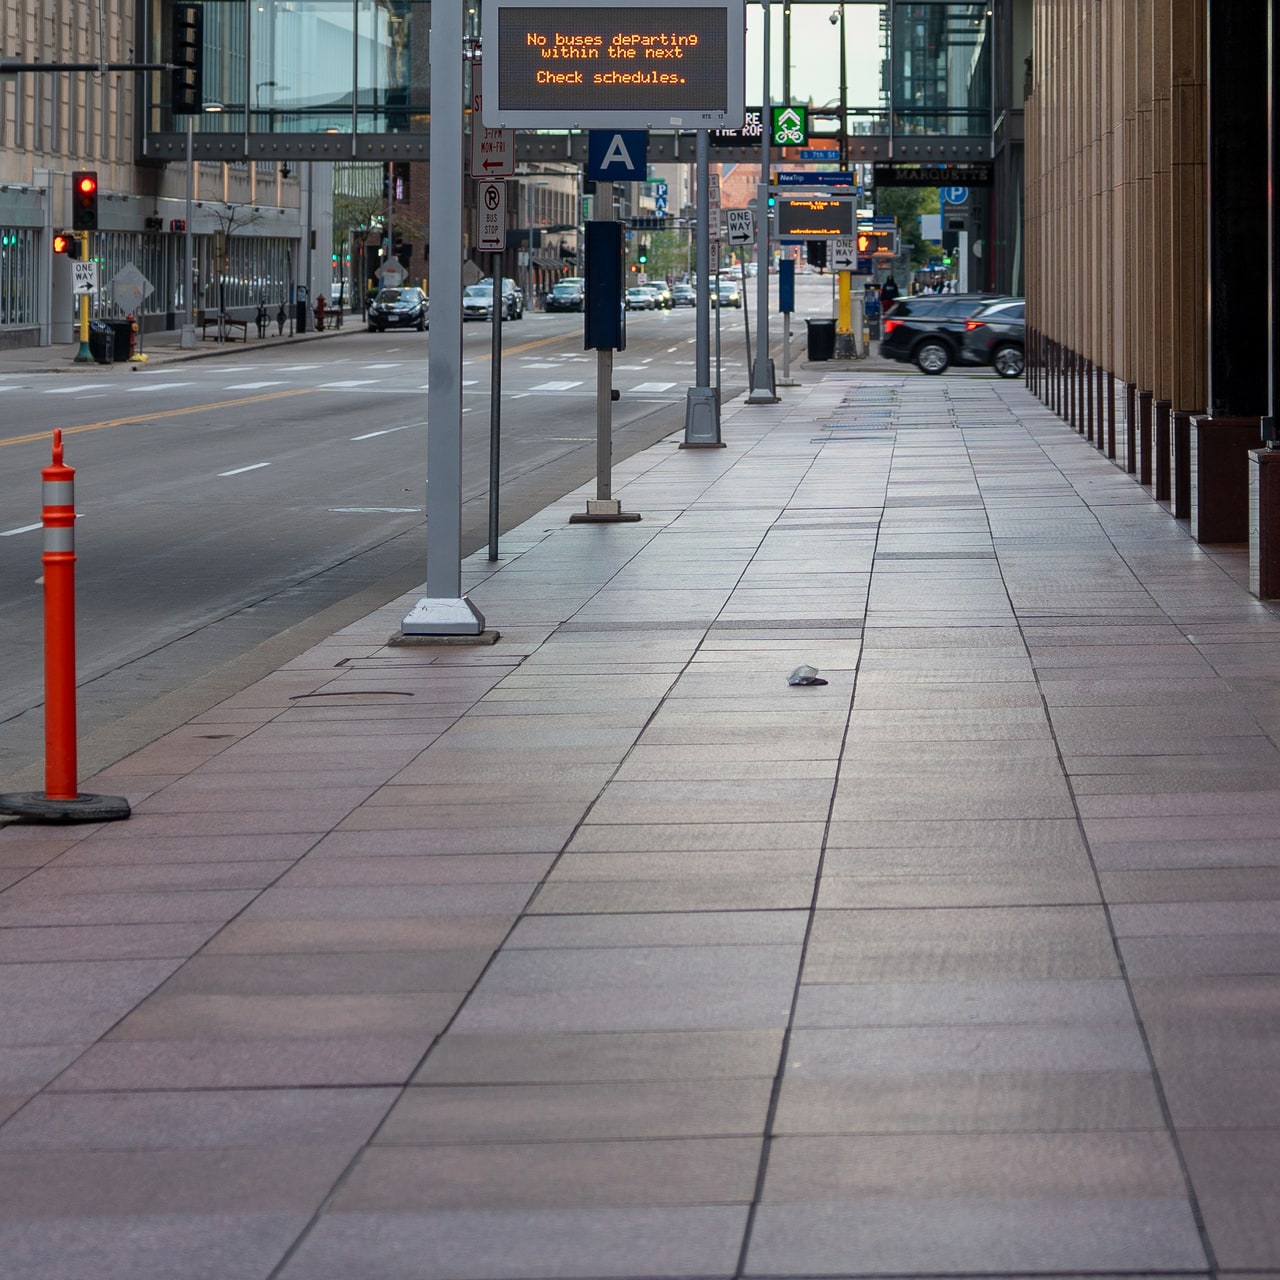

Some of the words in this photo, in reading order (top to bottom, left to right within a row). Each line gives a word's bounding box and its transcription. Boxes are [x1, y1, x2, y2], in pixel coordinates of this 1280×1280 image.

[527, 32, 547, 46] No
[555, 32, 603, 46] buses
[541, 45, 599, 59] within
[607, 45, 637, 59] the
[645, 45, 684, 59] next
[536, 70, 583, 84] Check
[593, 70, 687, 84] schedules.
[745, 112, 761, 124] RE
[480, 142, 506, 153] MON-FRI
[599, 134, 635, 170] A
[803, 150, 808, 158] S
[812, 150, 825, 158] 7th
[827, 150, 836, 158] St
[780, 174, 805, 182] NexTrip
[896, 170, 988, 180] MARQUETTE
[486, 214, 498, 222] BUS
[729, 211, 750, 221] ONE
[484, 225, 499, 234] STOP
[729, 222, 751, 232] WAY
[836, 240, 853, 248] ONE
[835, 249, 854, 257] WAY
[75, 264, 93, 272] ONE
[75, 273, 94, 281] WAY
